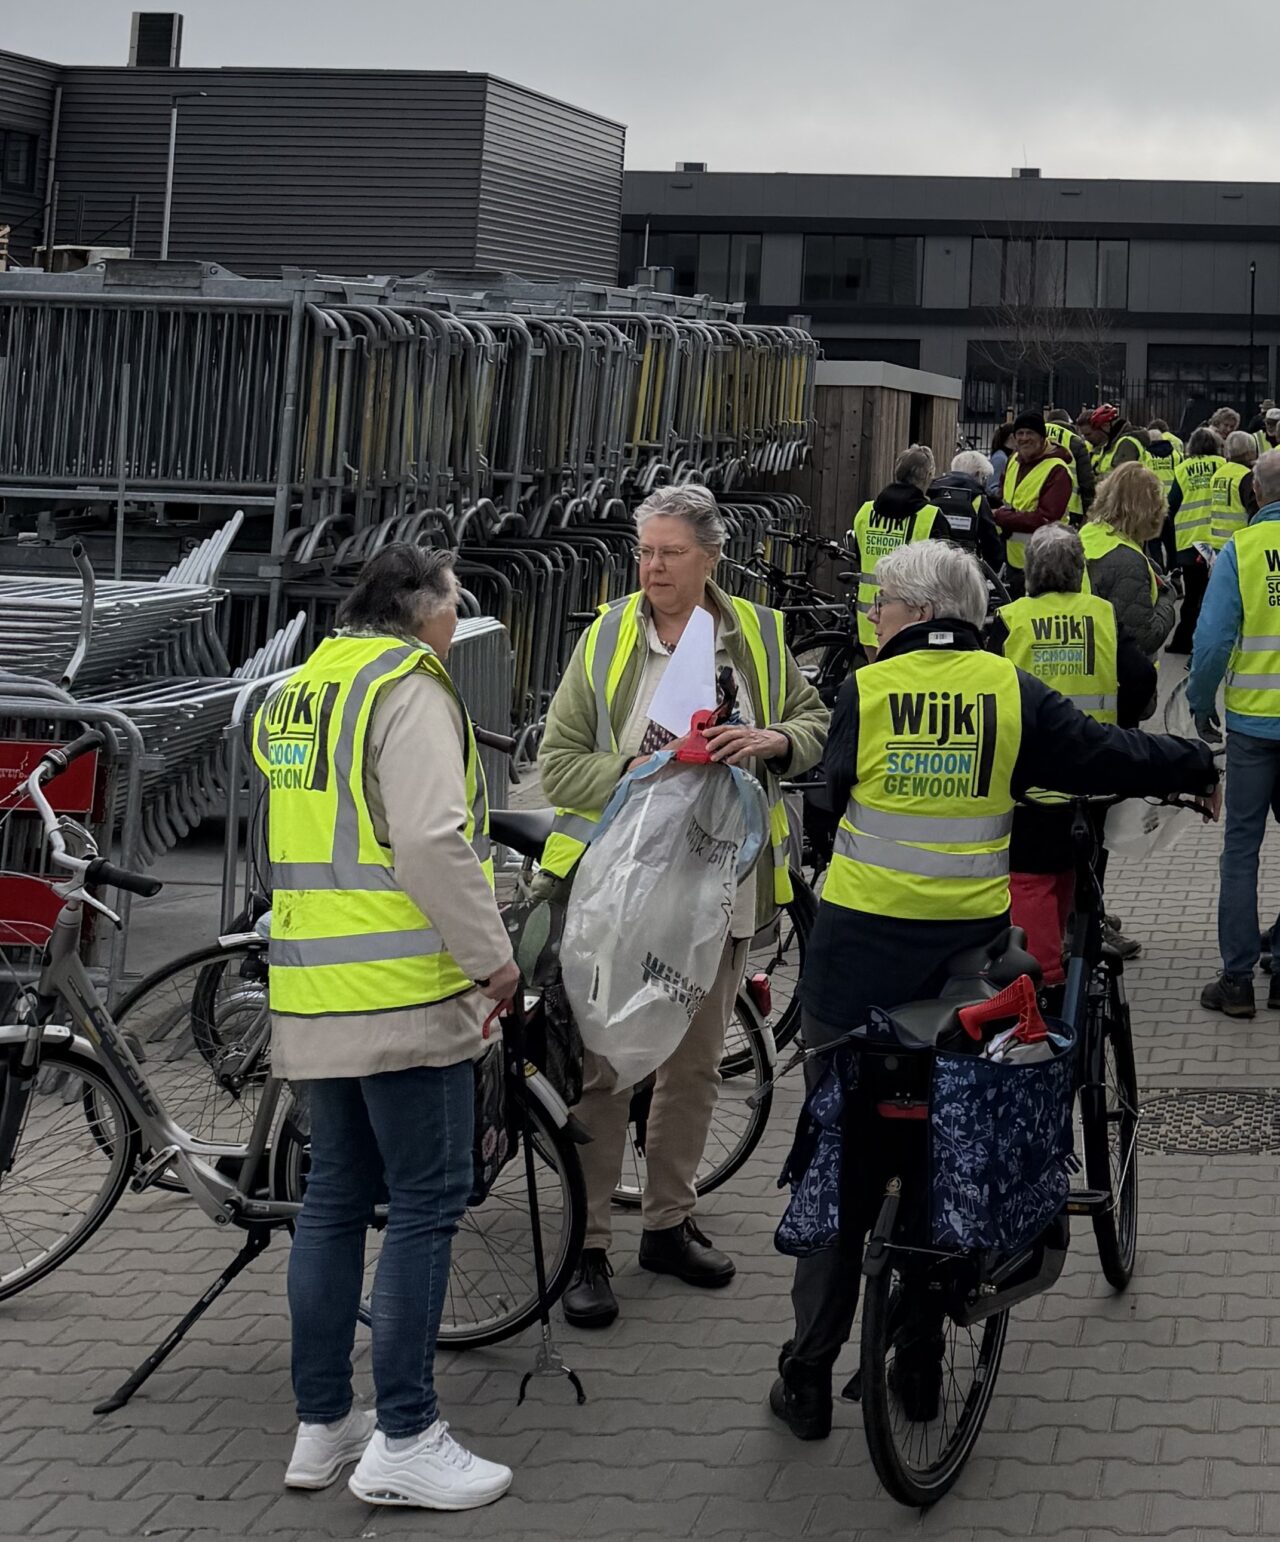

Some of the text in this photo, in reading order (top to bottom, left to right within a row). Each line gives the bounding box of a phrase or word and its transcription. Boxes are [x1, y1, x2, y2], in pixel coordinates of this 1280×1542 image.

[865, 546, 897, 556] GEWO
[866, 535, 901, 547] SCHOON
[1031, 614, 1083, 645] Wijk
[1034, 649, 1083, 662] SCHOON
[1033, 663, 1083, 676] GEWOON
[888, 691, 976, 746] Wijk
[886, 752, 972, 774] SCHOON
[884, 775, 970, 797] GEWOON
[91, 1005, 159, 1118] Gazelle
